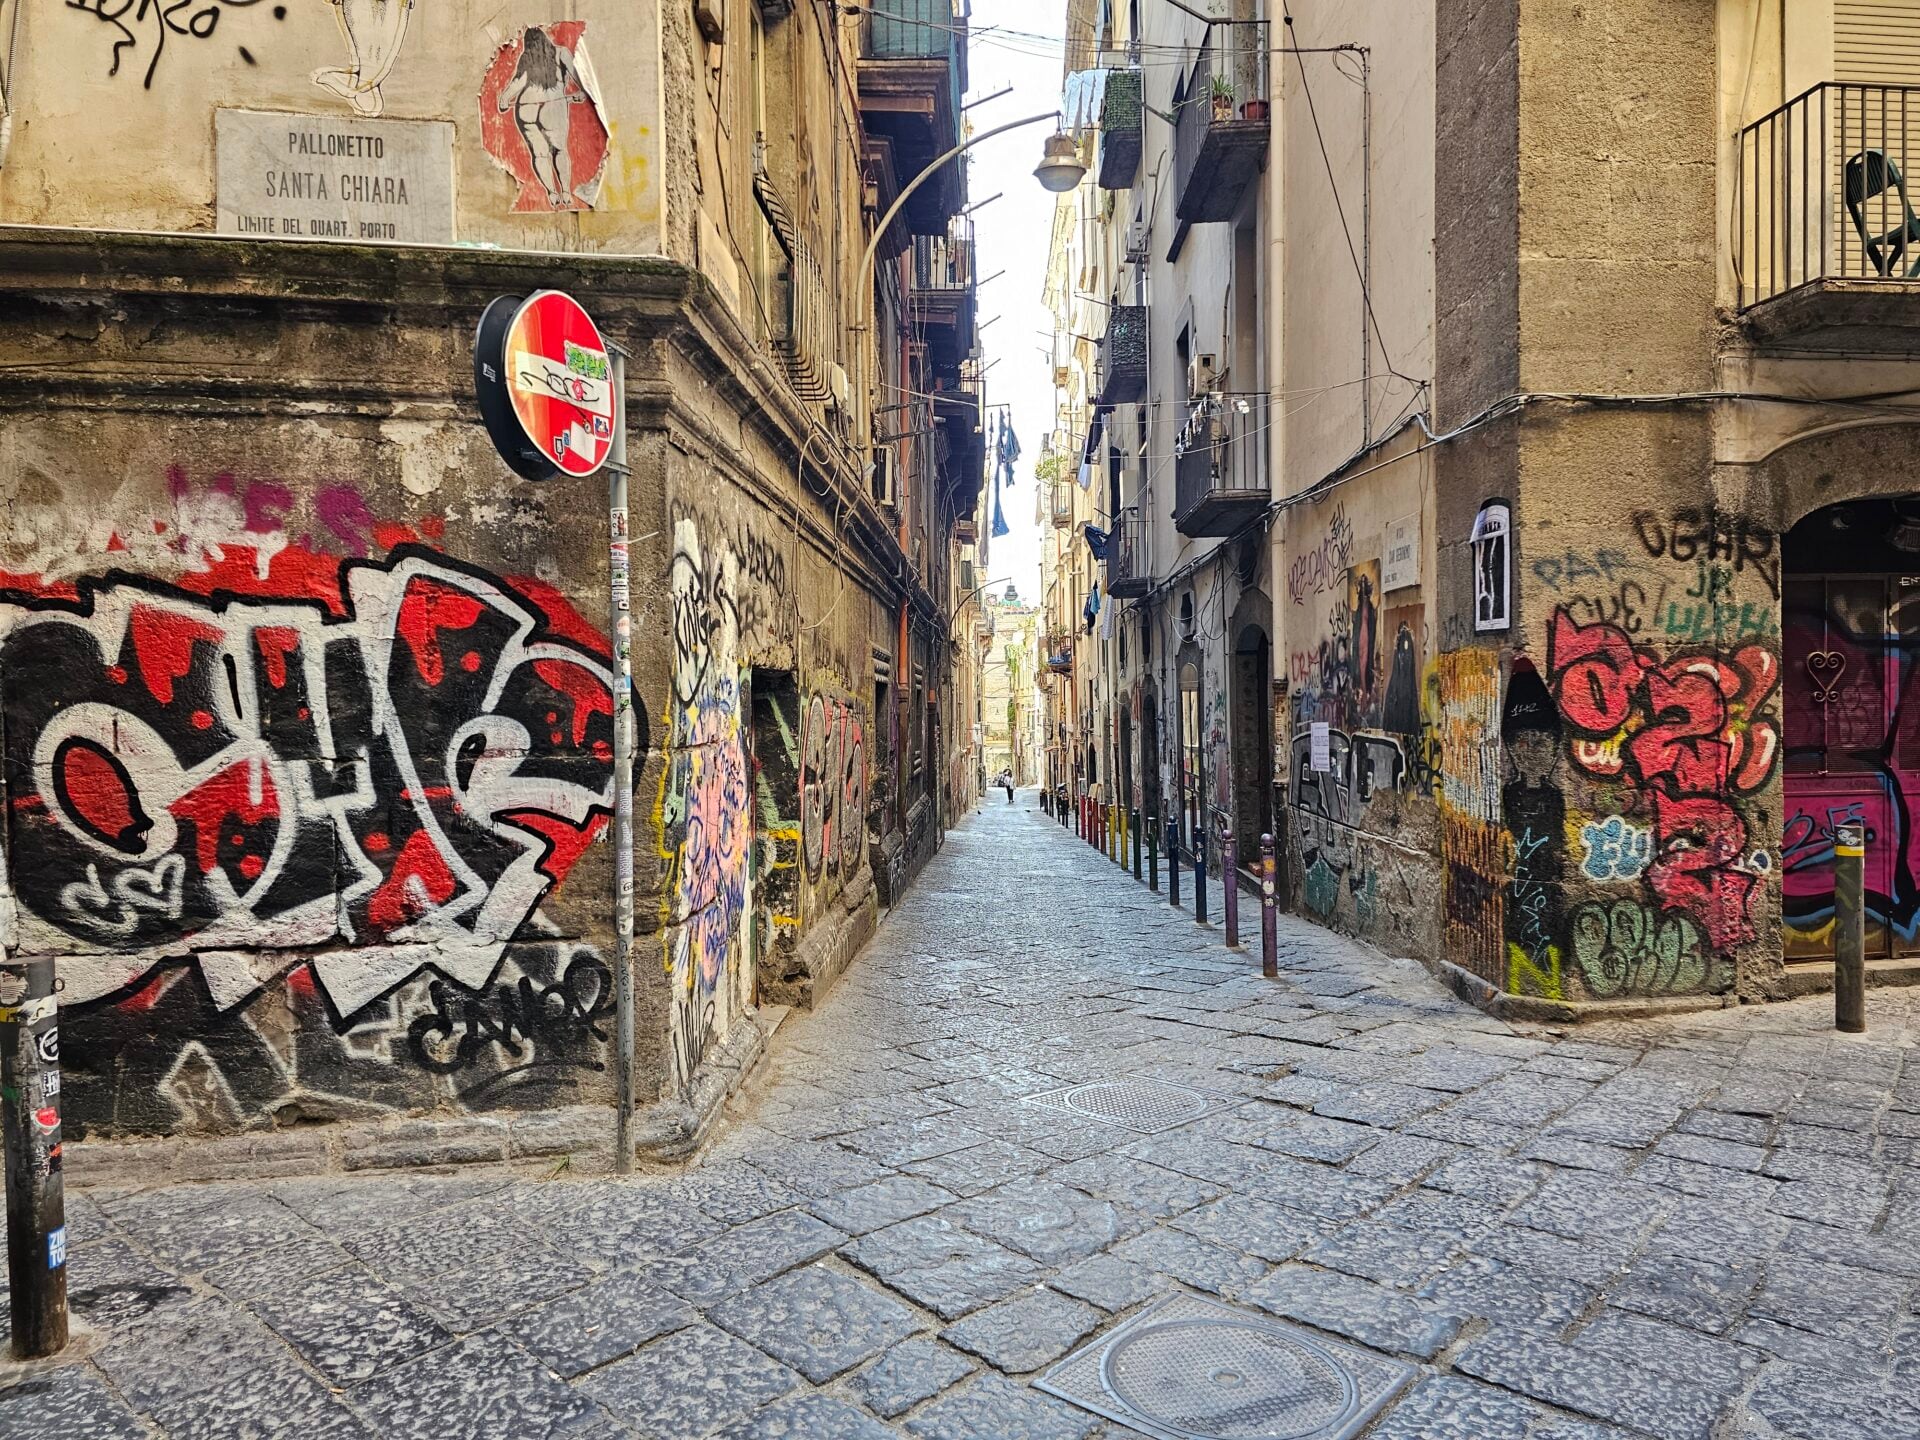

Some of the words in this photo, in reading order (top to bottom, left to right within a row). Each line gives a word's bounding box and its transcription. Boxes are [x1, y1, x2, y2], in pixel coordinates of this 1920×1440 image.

[288, 132, 384, 159] PALLONETTO
[266, 170, 329, 201] SANTA
[340, 174, 409, 205] CHIARA
[237, 215, 275, 234] LIMITE
[283, 218, 303, 235] DEL
[310, 219, 352, 238] QUART.
[360, 221, 396, 239] PORTO
